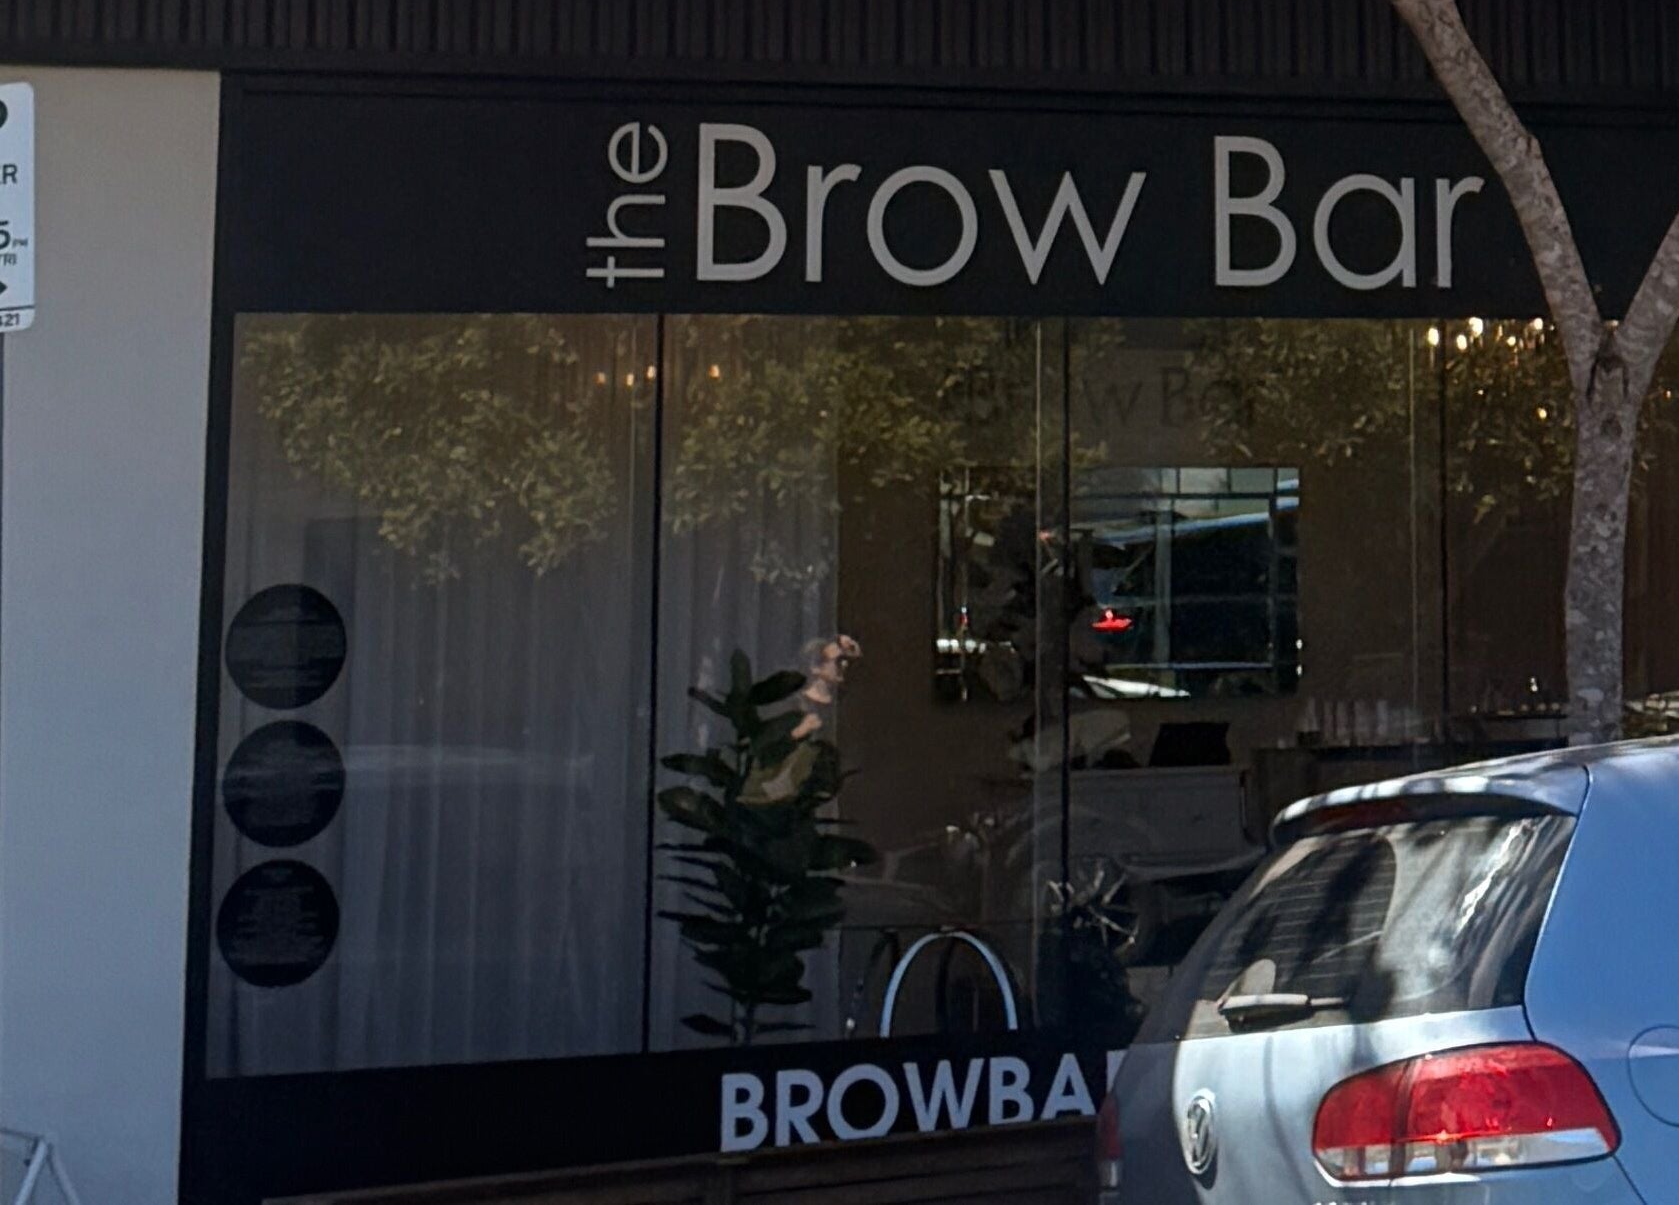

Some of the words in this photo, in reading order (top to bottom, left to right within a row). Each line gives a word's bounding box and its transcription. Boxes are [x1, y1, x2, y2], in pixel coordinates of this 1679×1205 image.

[586, 121, 668, 288] the
[696, 122, 1147, 286] Brow
[1214, 135, 1484, 290] Bar
